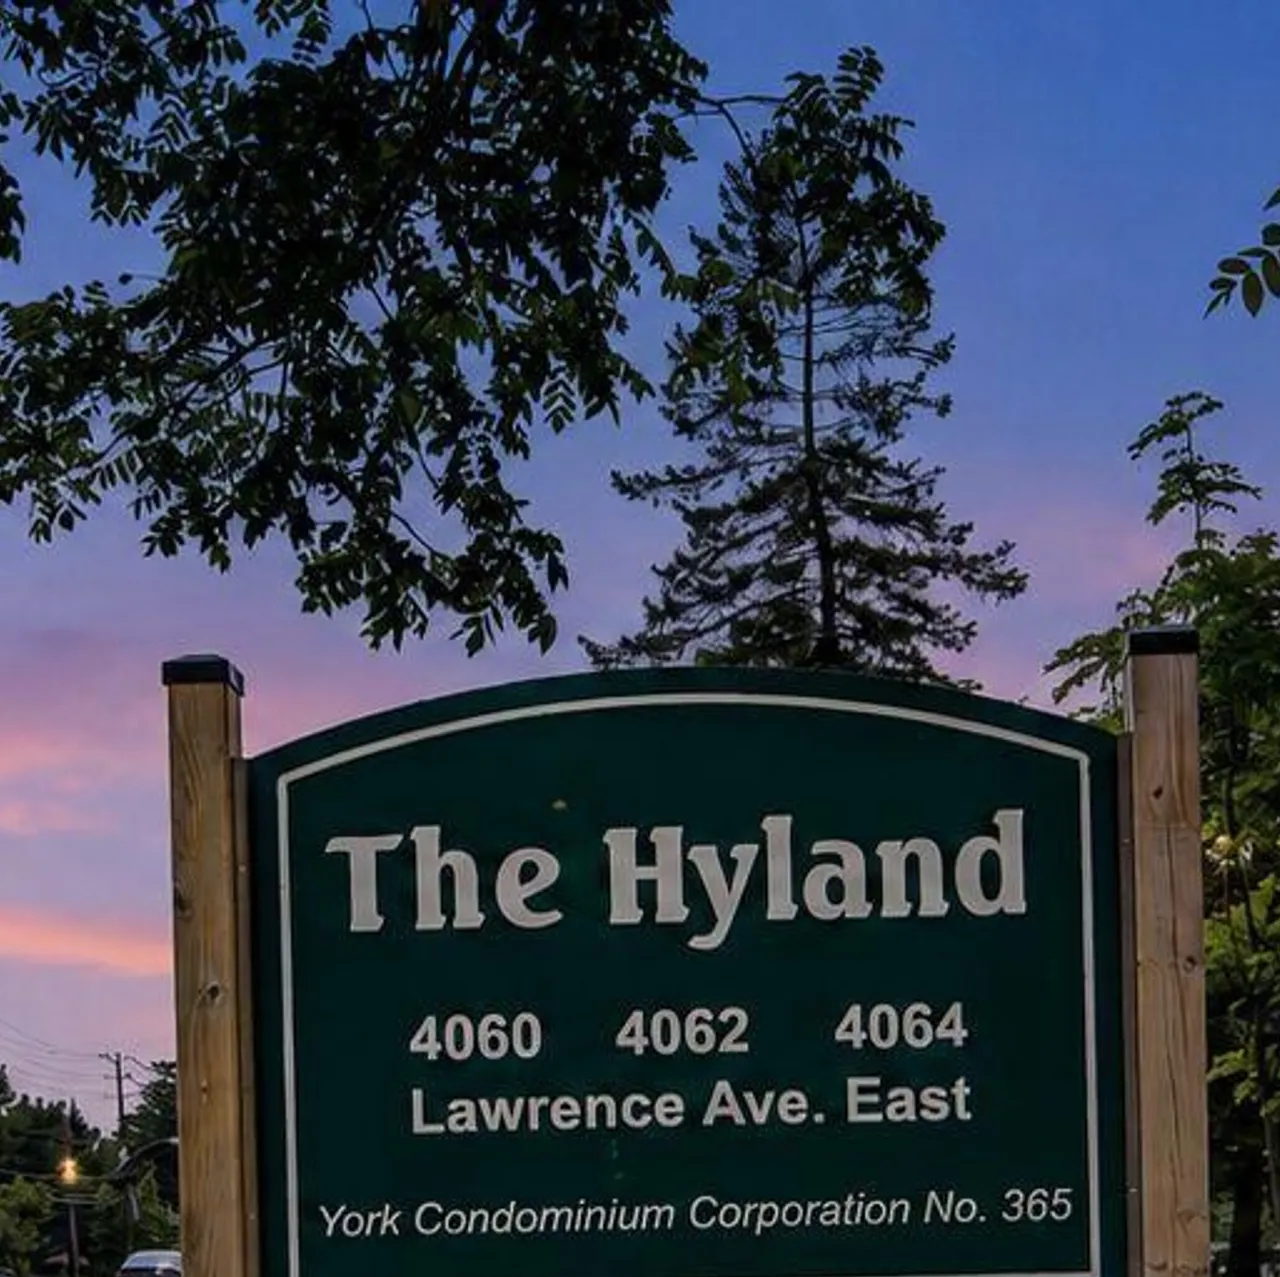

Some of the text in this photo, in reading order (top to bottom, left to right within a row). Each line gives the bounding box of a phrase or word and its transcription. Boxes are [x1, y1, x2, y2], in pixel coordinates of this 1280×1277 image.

[324, 808, 1028, 950] The Hyland
[408, 1001, 969, 1061] 4060 4062 4064
[411, 1075, 973, 1135] Lawrence Ave. East
[318, 1187, 1073, 1238] York Condominium Corporation No. 365
